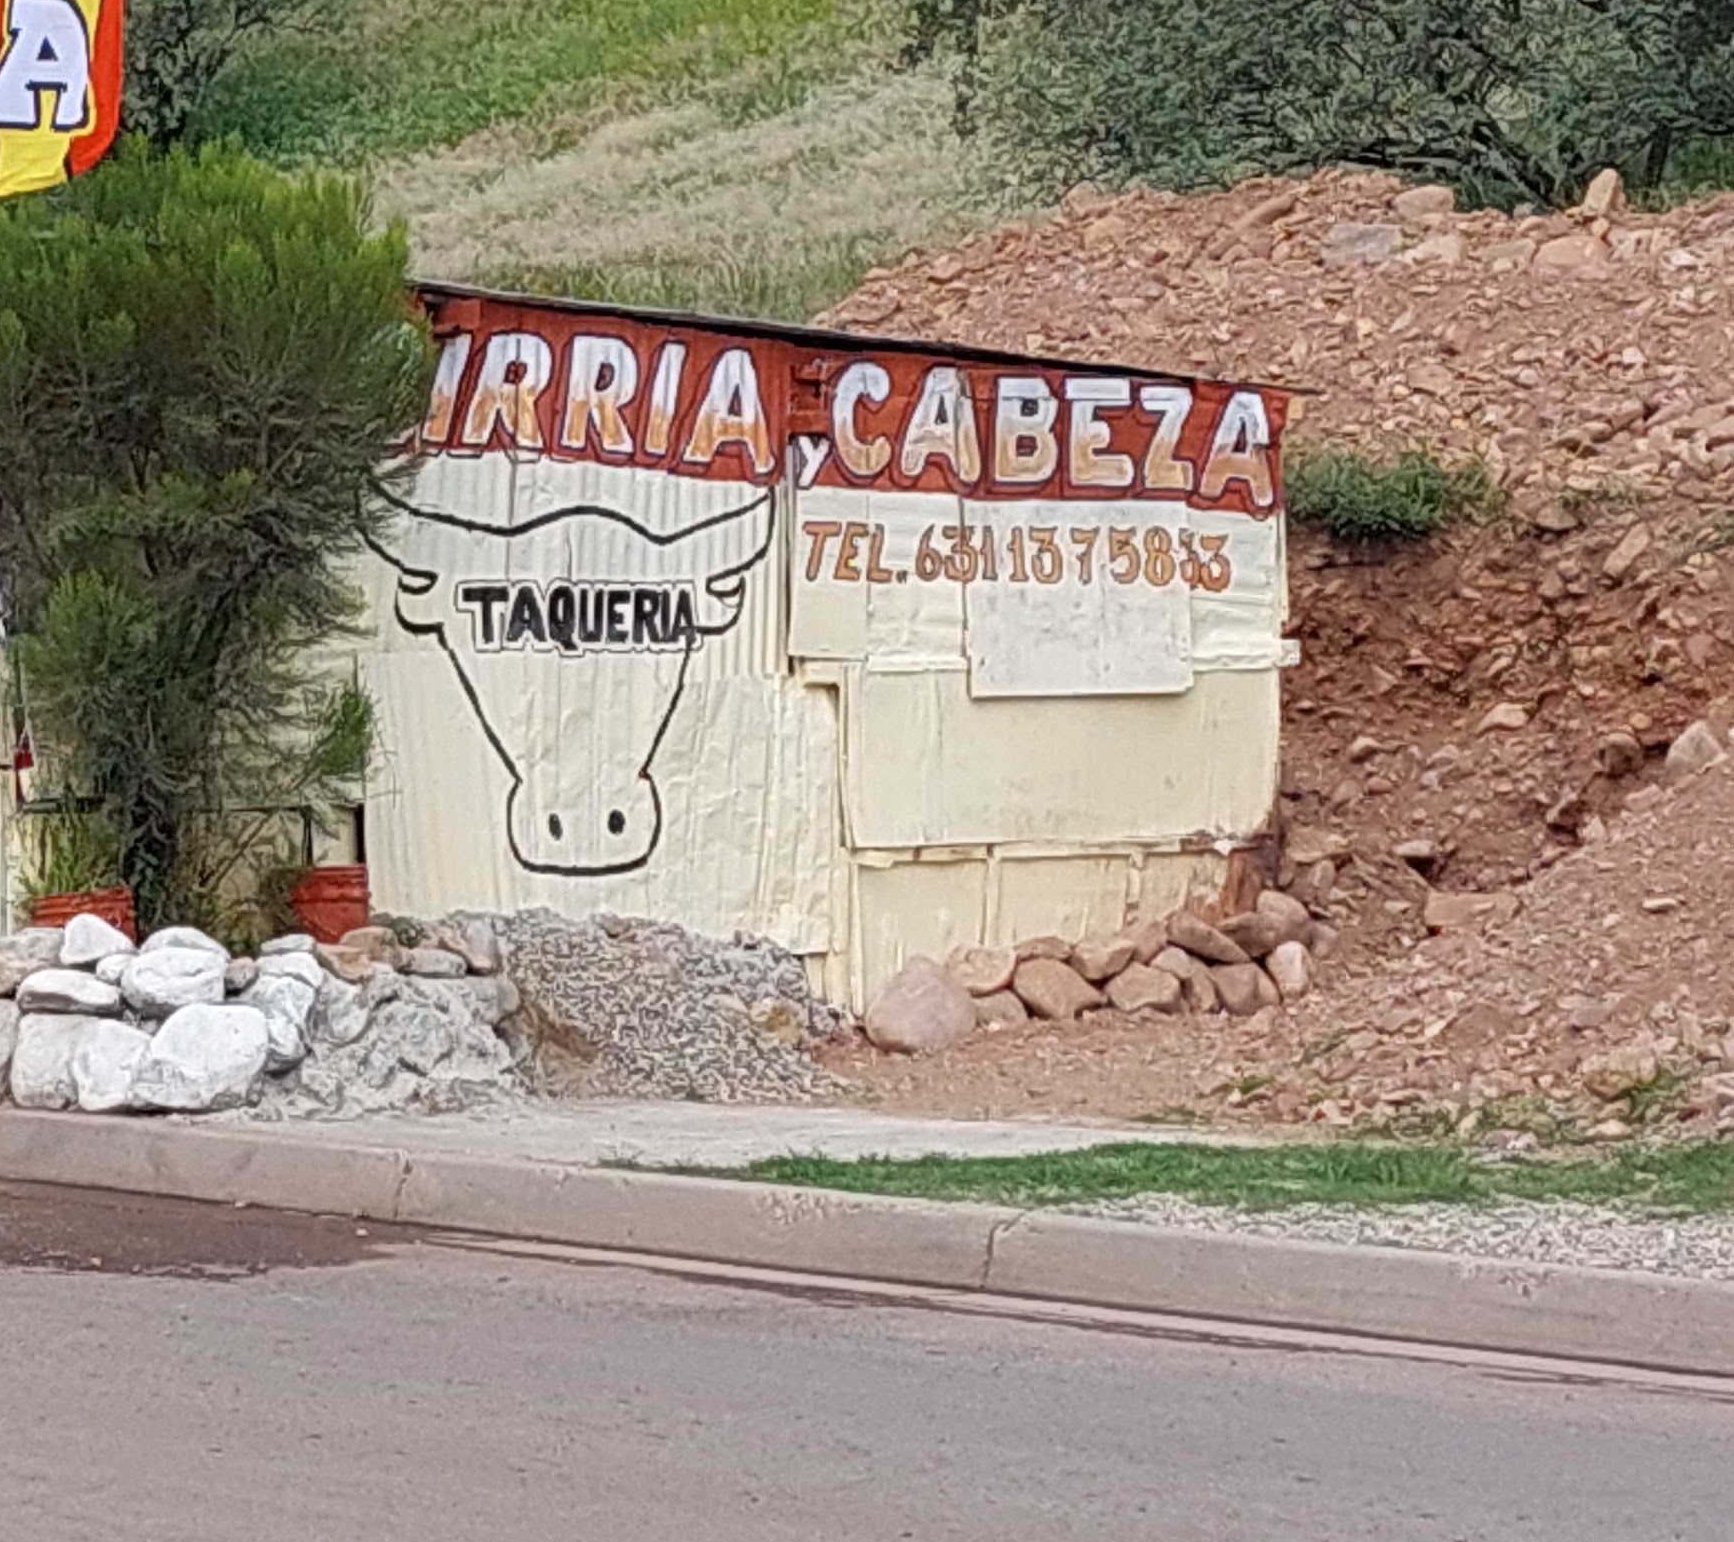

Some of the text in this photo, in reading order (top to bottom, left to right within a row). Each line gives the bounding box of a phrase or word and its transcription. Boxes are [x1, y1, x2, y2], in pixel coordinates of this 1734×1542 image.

[390, 332, 777, 476] IRRIA
[832, 361, 1276, 511] CABEZA
[462, 585, 698, 652] TAQUERIA
